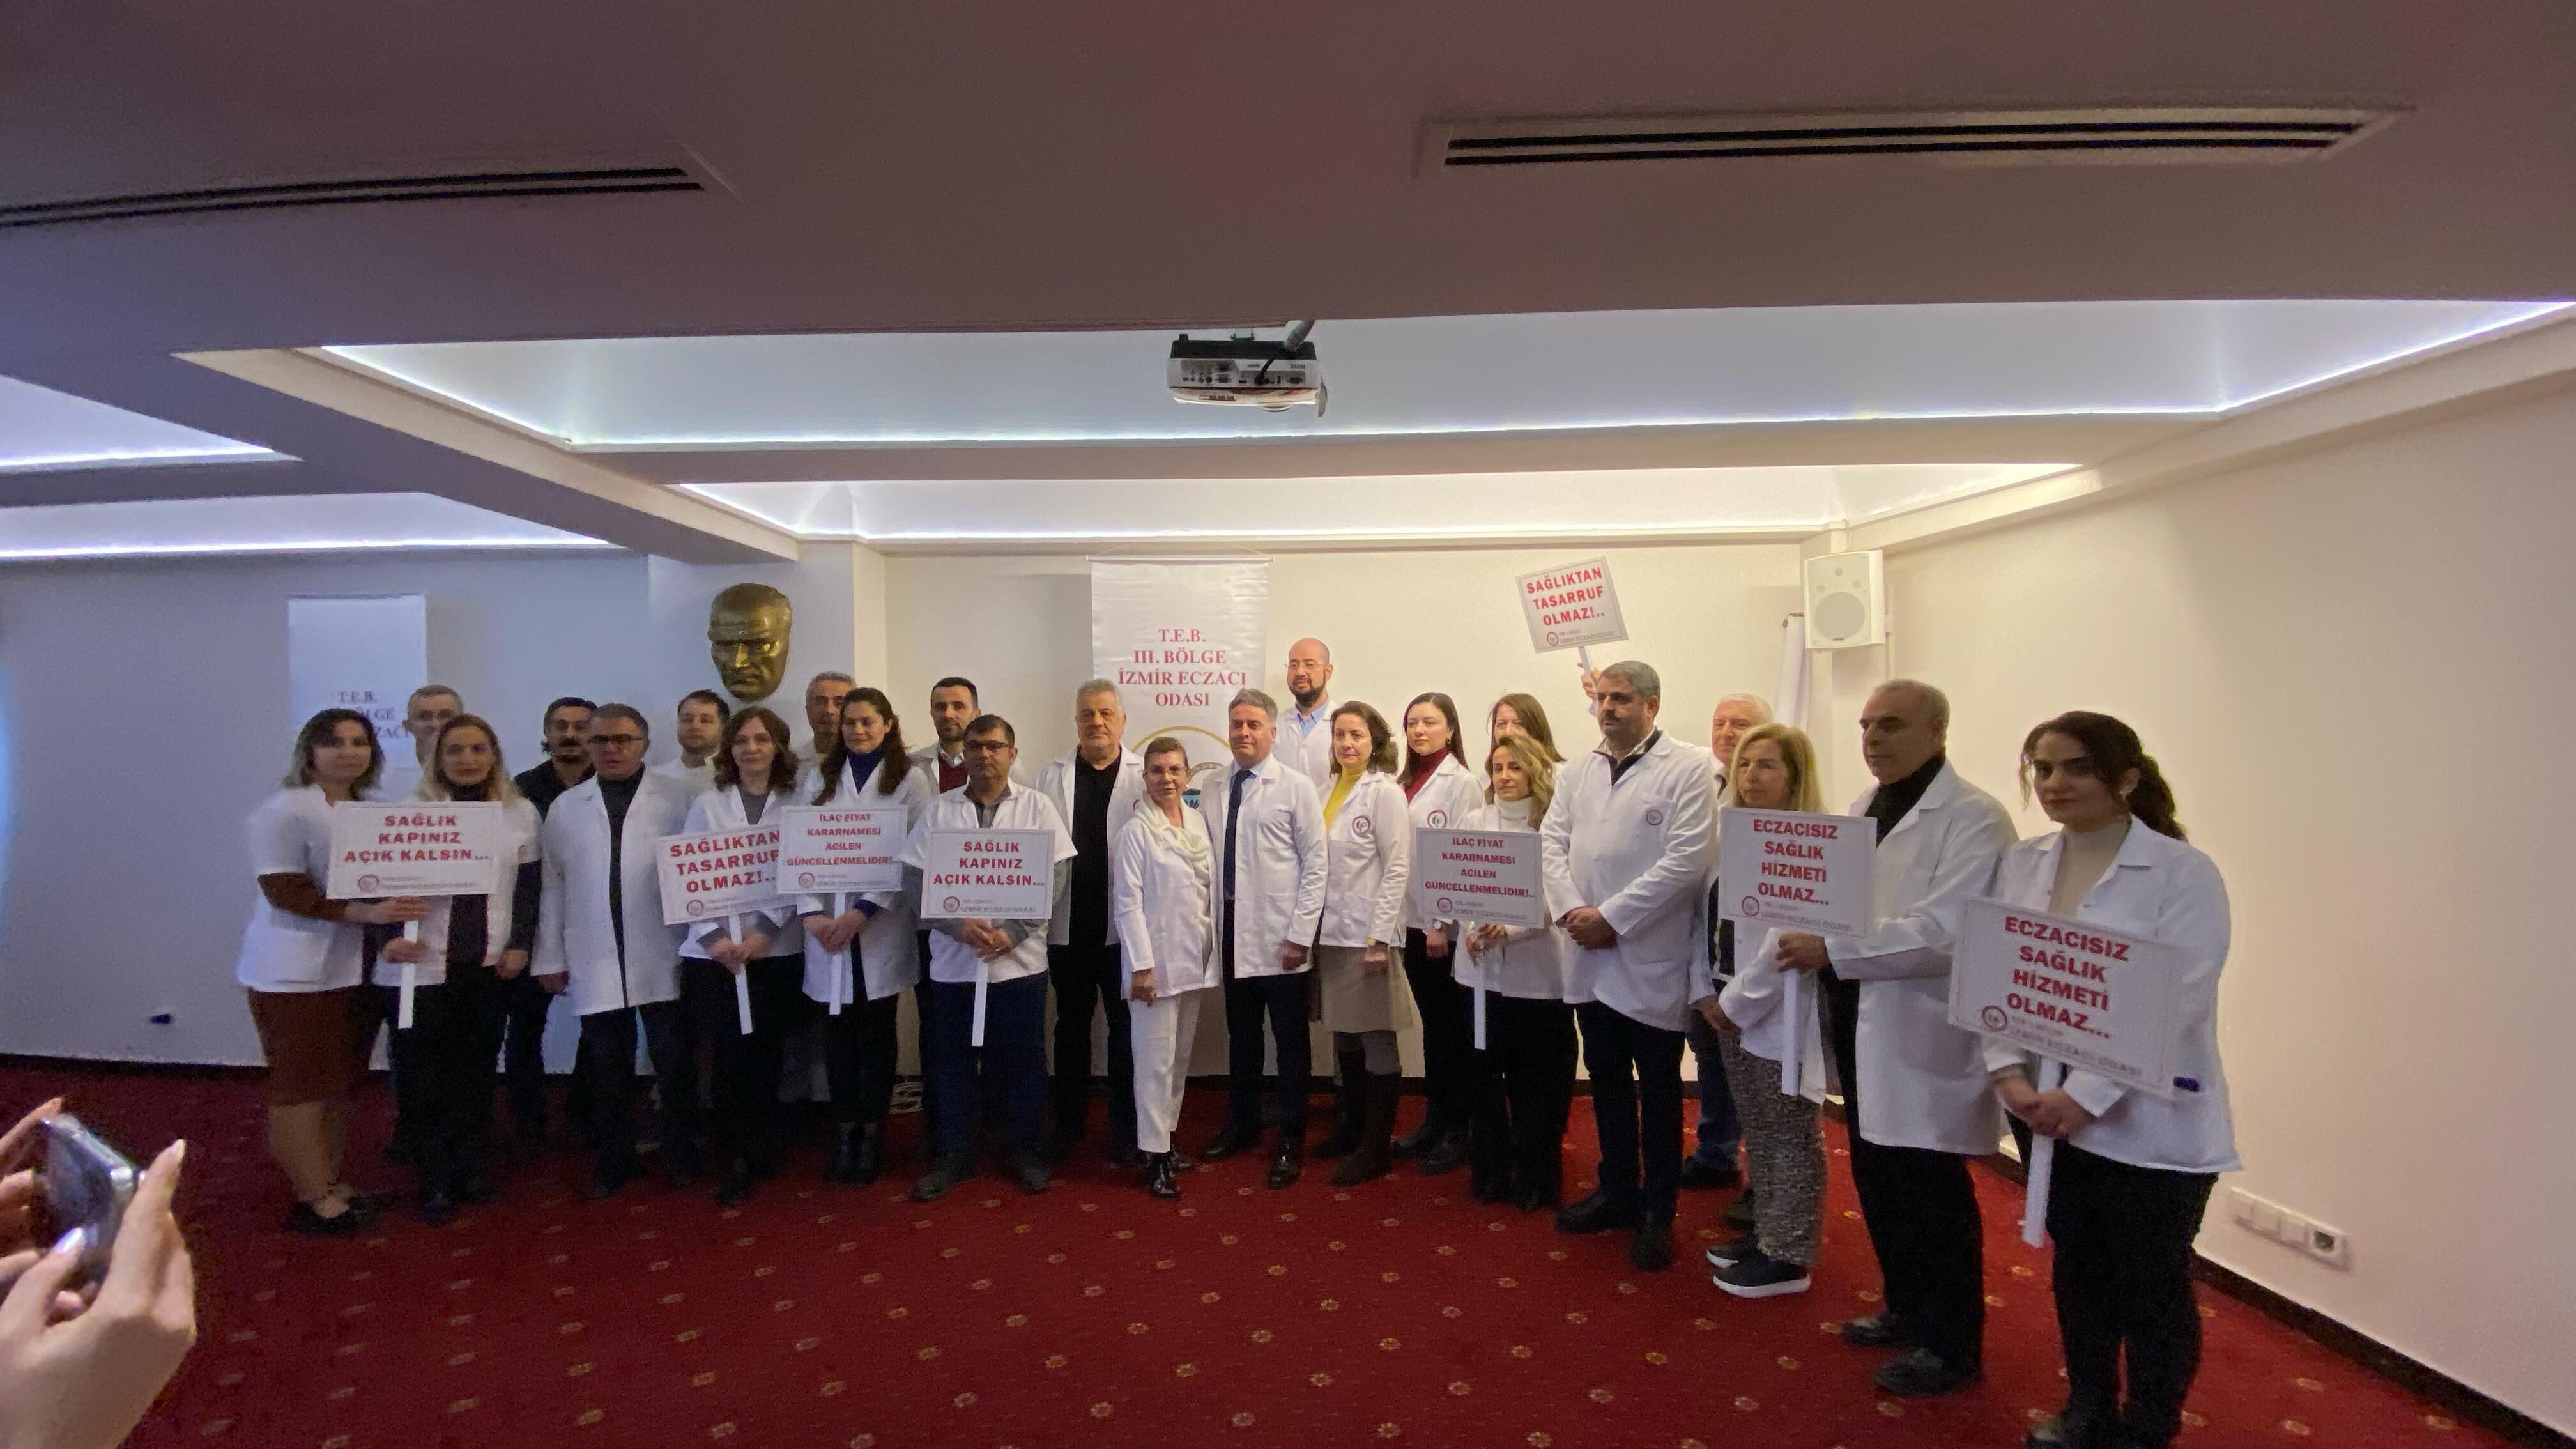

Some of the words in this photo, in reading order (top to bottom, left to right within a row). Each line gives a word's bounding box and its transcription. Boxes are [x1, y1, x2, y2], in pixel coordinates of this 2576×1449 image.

[1526, 567, 1603, 594] SAĞLIKTAN
[1533, 585, 1604, 610] TASARRUF
[1543, 606, 1605, 626] OLMAZ!..
[1158, 629, 1206, 643] T.E.B.
[1133, 650, 1160, 664] III.
[1164, 647, 1226, 664] BÖLGE
[1118, 668, 1172, 686] İZMİR
[1178, 671, 1246, 686] ECZACI
[1155, 693, 1210, 707] ODASI
[384, 813, 457, 827] SAĞLIK
[819, 812, 842, 823] İLAÇ
[379, 832, 461, 845] KAPINIZ
[1754, 818, 1838, 839] ECZACISIZ
[670, 829, 780, 857] SAĞLIKTAN
[963, 839, 1019, 852] SAĞLIK
[1477, 837, 1503, 848] FİYAT
[1764, 839, 1824, 860] SAĞLIK
[344, 850, 393, 864] AÇIK
[401, 849, 490, 861] KALSIN...
[676, 849, 779, 875] TASARRUF
[959, 858, 1022, 869] KAPINIZ
[933, 873, 970, 886] AÇIK
[976, 874, 1045, 885] KALSIN...
[1761, 861, 1827, 882] HİZMETİ
[686, 871, 776, 893] OLMAZ!..
[1758, 882, 1829, 905] OLMAZ...
[2004, 916, 2130, 961] ECZACISIZ
[2019, 945, 2107, 983] SAĞLIK
[2012, 969, 2108, 1011] HİZMETİ
[2007, 992, 2110, 1039] OLMAZ...
